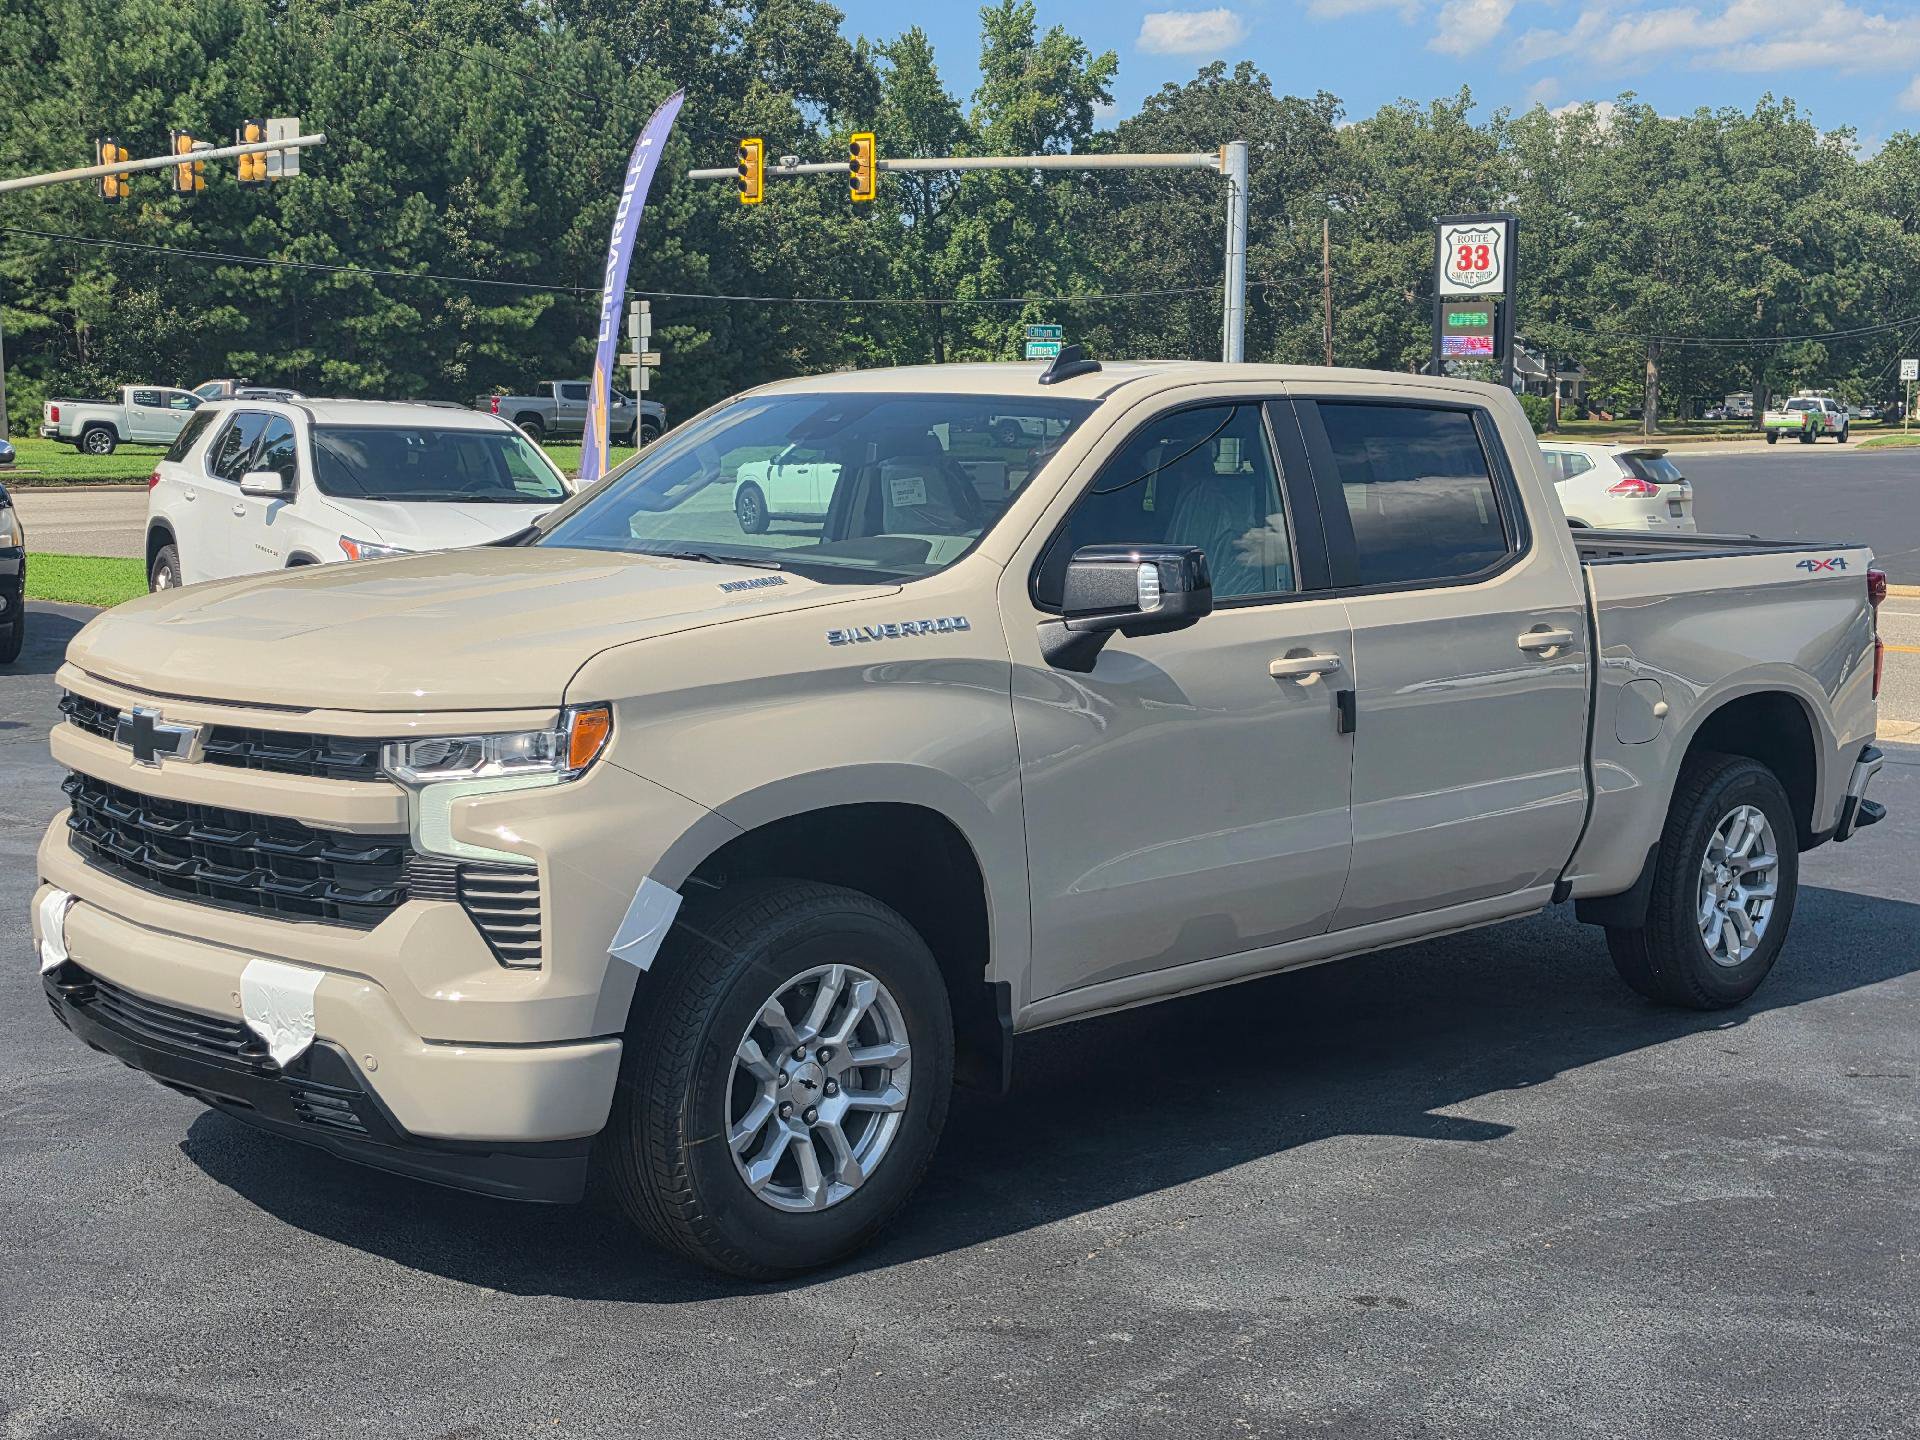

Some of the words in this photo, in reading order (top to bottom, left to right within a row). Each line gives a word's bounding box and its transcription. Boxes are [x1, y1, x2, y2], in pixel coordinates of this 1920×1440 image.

[1457, 234, 1489, 244] ROUTE
[1456, 244, 1490, 271] 33
[1451, 271, 1474, 284] SMOKE
[1475, 270, 1493, 282] SHOP
[1902, 369, 1916, 377] 45
[826, 616, 970, 646] SILVERADO
